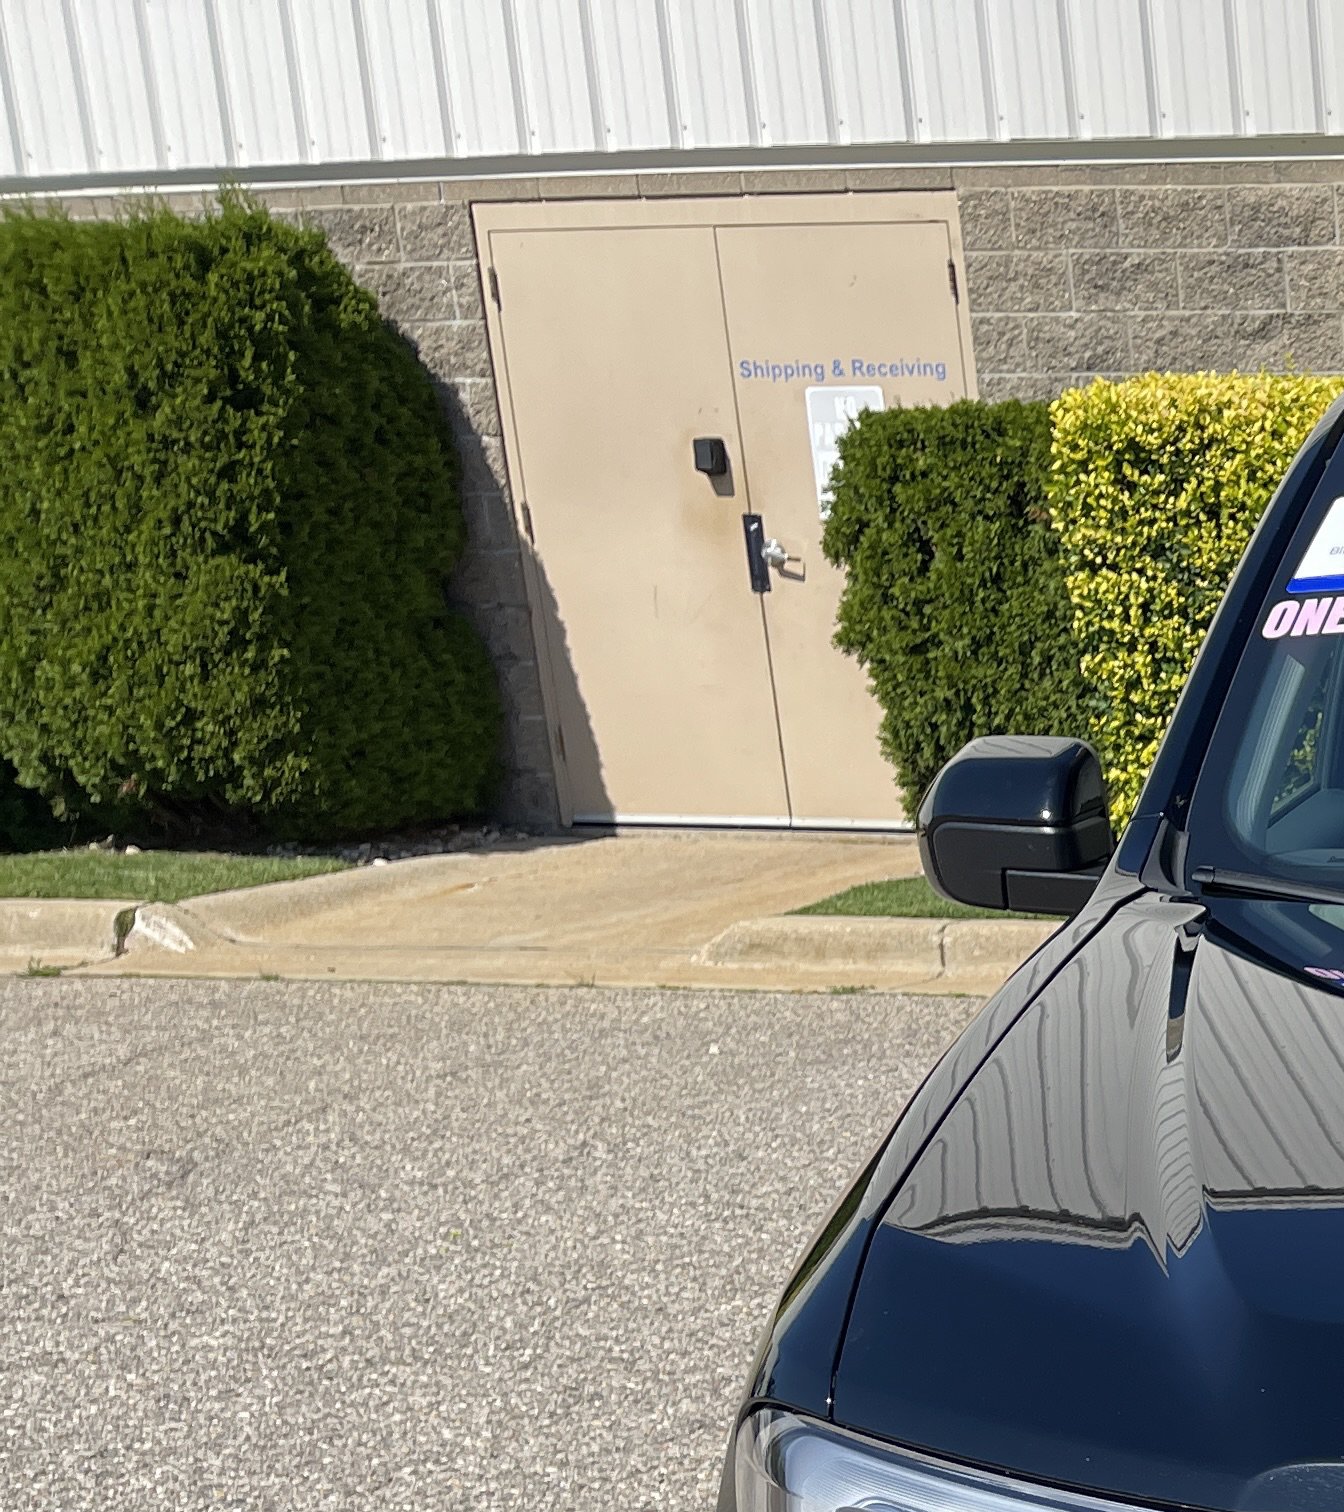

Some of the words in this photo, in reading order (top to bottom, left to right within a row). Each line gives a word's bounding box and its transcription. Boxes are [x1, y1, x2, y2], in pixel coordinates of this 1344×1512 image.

[739, 360, 825, 382] Shipping
[831, 360, 844, 377] &
[851, 358, 946, 381] Receiving
